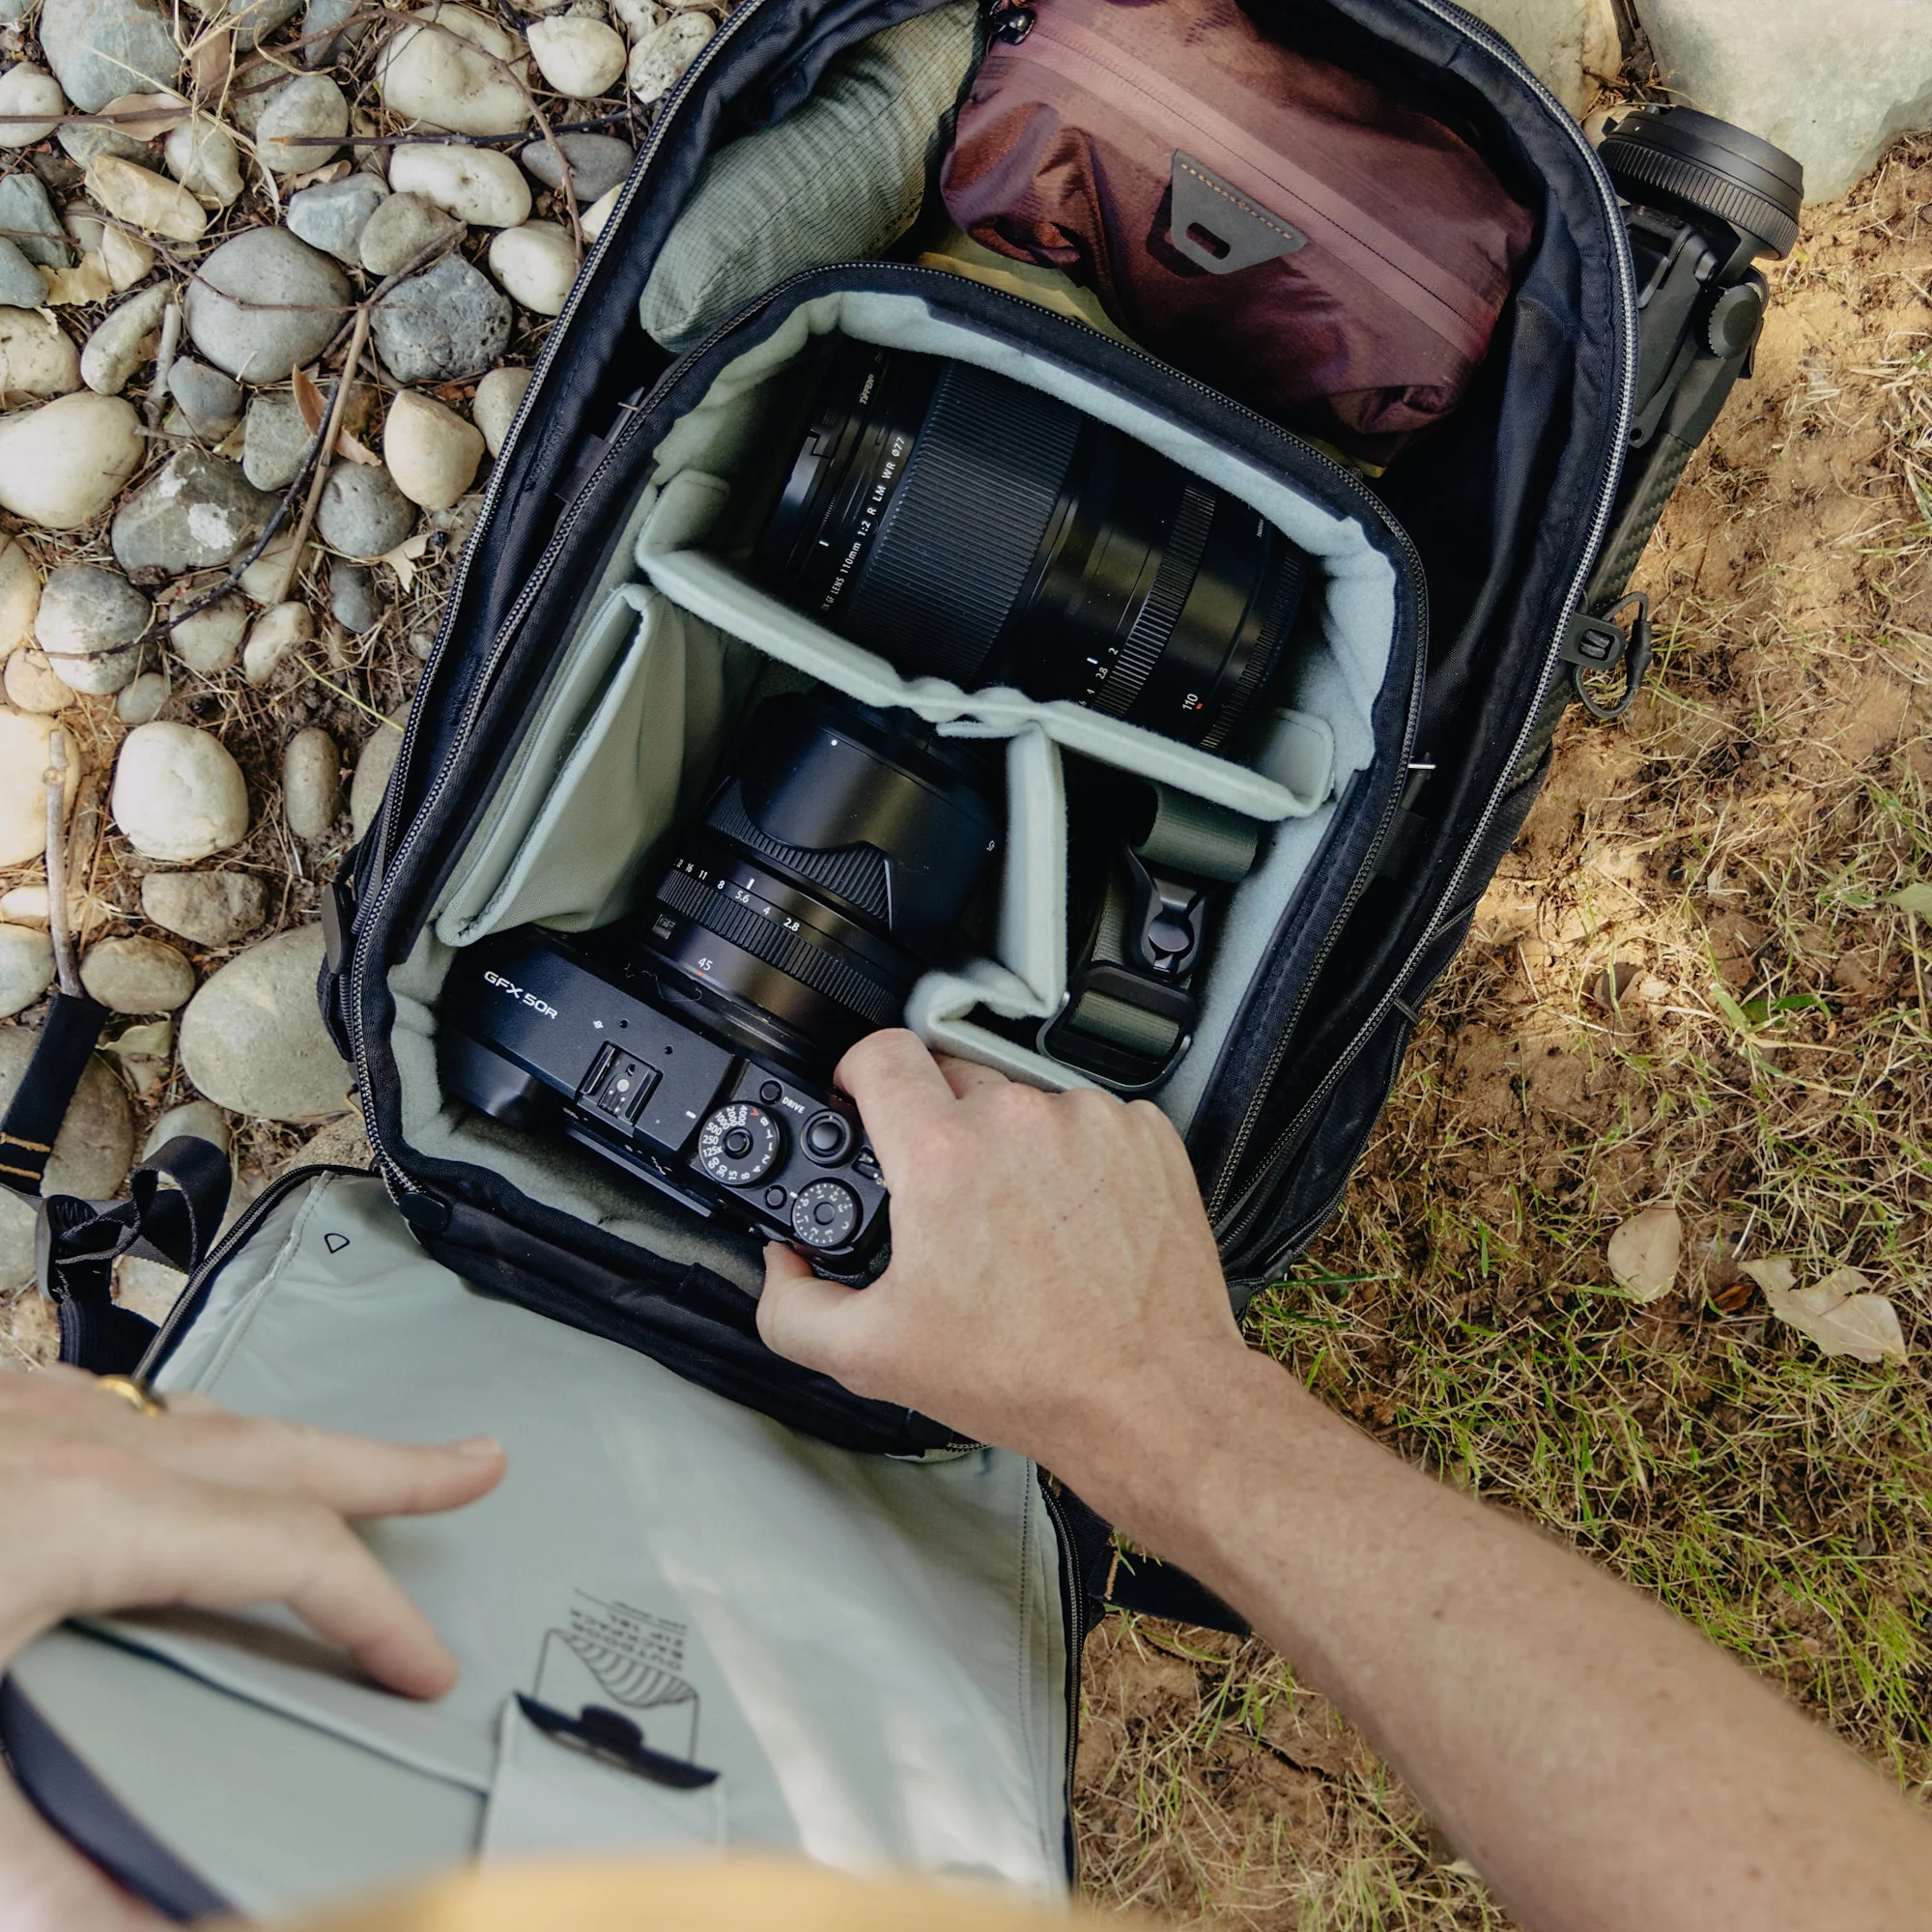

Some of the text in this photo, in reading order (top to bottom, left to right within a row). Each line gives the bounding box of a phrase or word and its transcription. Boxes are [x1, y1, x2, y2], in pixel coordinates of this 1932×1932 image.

[831, 577, 845, 595] LENS
[839, 542, 862, 574] 110mm
[857, 521, 871, 536] 1:2
[867, 507, 877, 516] R
[872, 485, 887, 502] LM
[881, 462, 896, 480] WR
[1108, 647, 1119, 656] 2
[1182, 693, 1198, 711] 110
[697, 869, 709, 880] 11
[717, 880, 725, 890] 8
[734, 890, 750, 904] 5.6
[762, 906, 771, 916] 4
[783, 918, 800, 932] 2.8
[697, 957, 713, 971] 45
[484, 971, 558, 1019] GFX 50R
[781, 1095, 805, 1114] DRIVE
[726, 1106, 738, 1126] 2000
[737, 1105, 748, 1126] 4000
[750, 1107, 759, 1117] A
[715, 1112, 730, 1130] 1000
[760, 1117, 769, 1126] B
[706, 1122, 723, 1136] 500
[766, 1129, 773, 1139] T
[702, 1135, 719, 1145] 250
[708, 1157, 720, 1169] 60
[761, 1154, 771, 1164] 2
[716, 1164, 727, 1178] 30
[728, 1170, 738, 1180] 15
